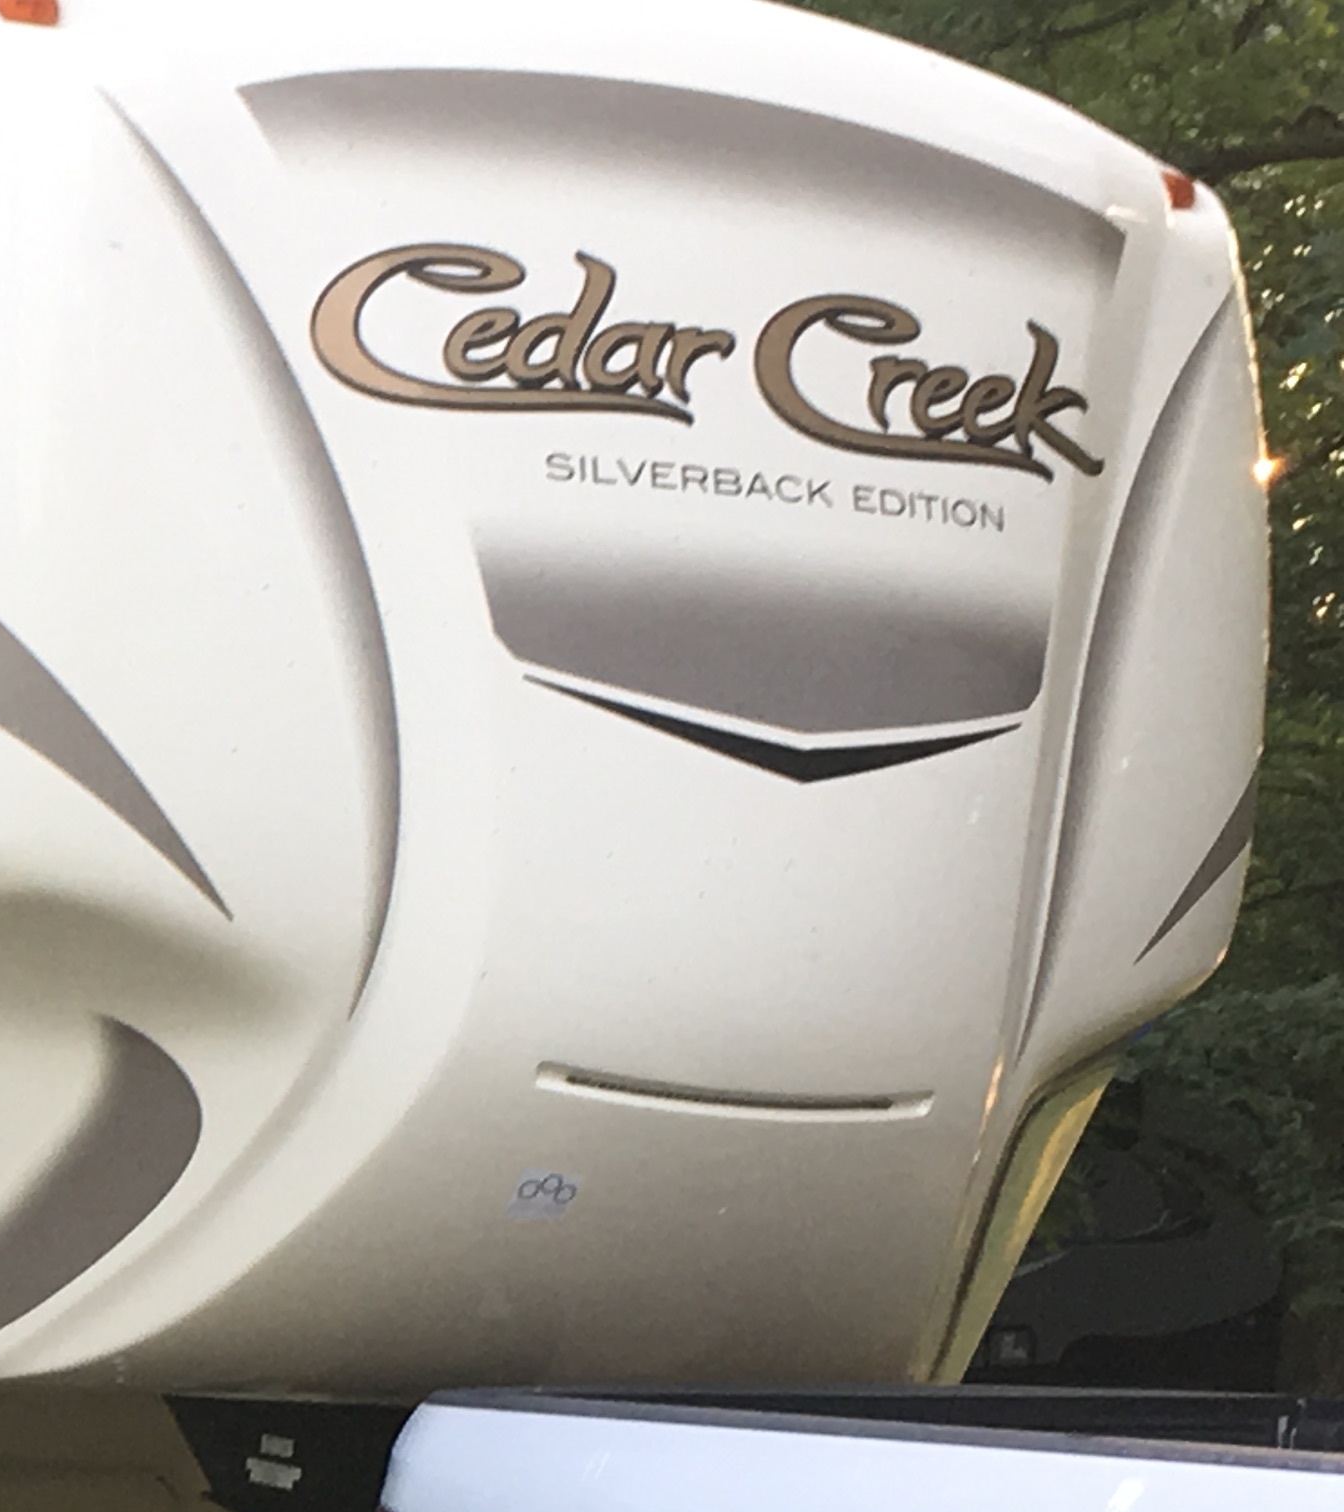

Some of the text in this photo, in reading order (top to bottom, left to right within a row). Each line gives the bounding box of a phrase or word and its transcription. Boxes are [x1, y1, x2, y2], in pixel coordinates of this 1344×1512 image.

[310, 242, 1105, 482] Cedar Creek
[544, 452, 1006, 532] SILVERBACK EDITION
